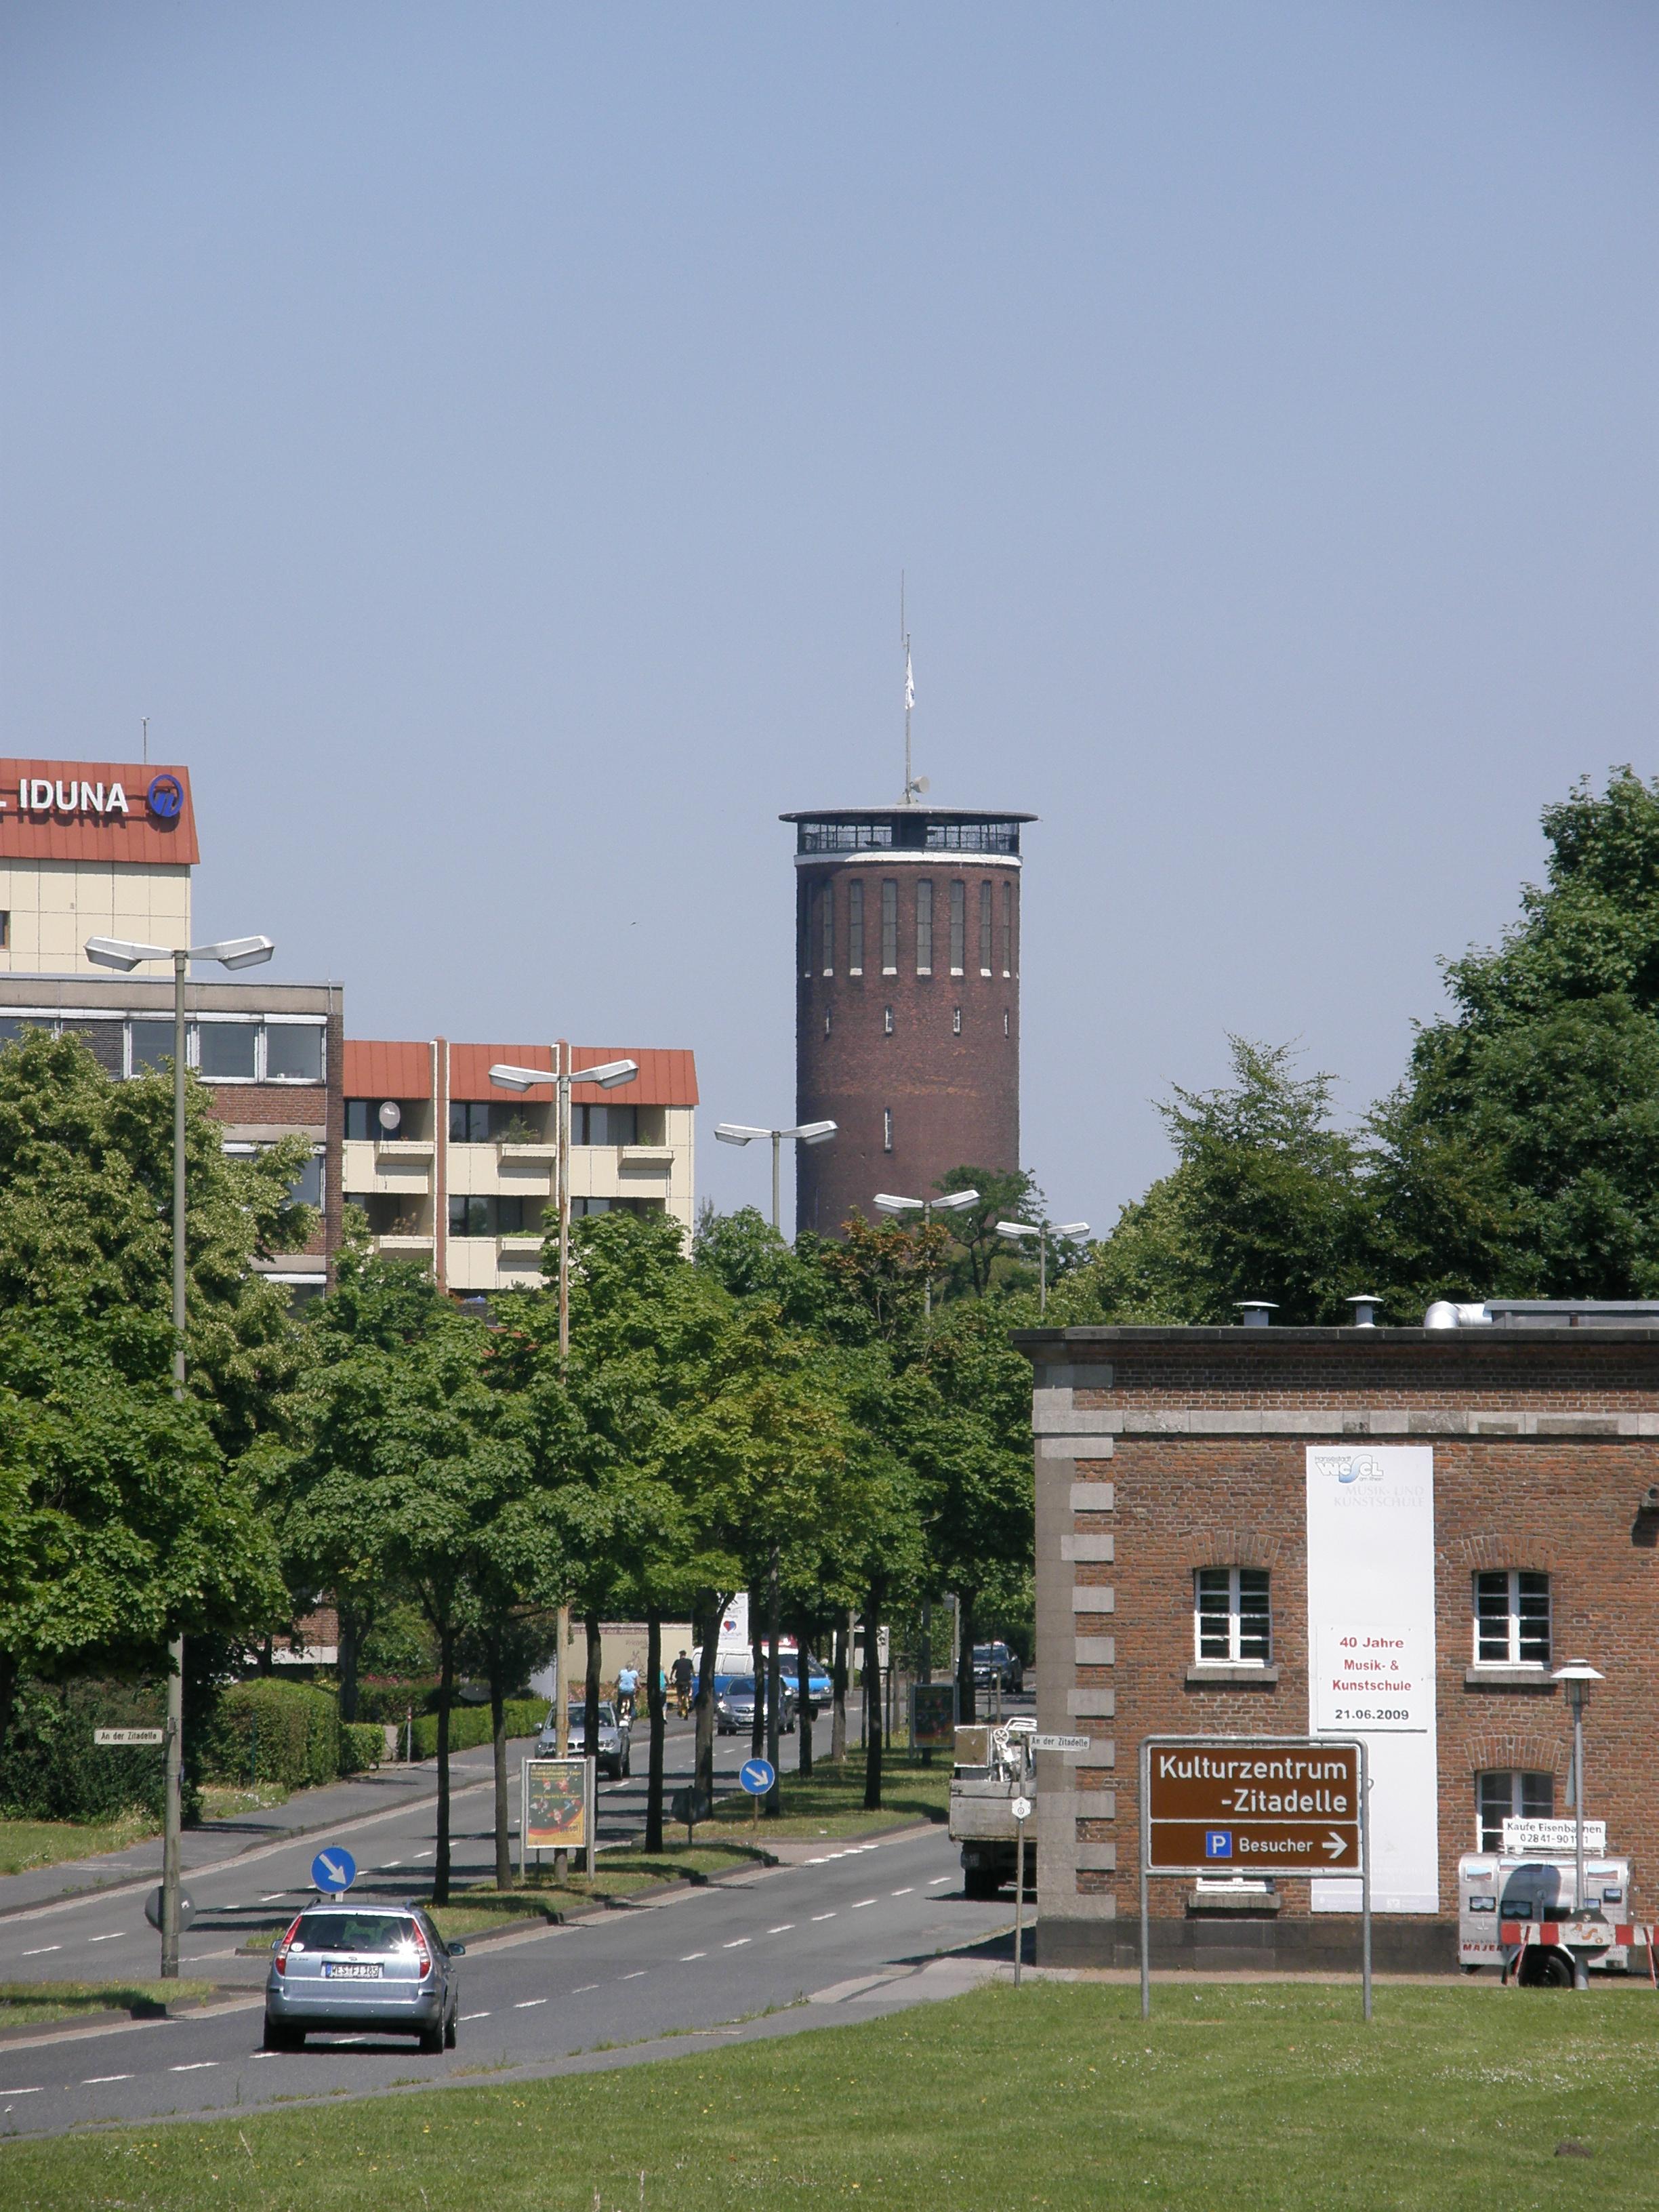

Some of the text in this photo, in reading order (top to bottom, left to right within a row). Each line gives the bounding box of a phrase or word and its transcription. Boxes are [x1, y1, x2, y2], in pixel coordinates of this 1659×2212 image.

[20, 779, 129, 813] IDUNA
[1395, 1485, 1425, 1496] UND
[1334, 1496, 1425, 1507] KUNSTSCHULE
[1339, 1637, 1404, 1648] 40 Jahre
[1344, 1660, 1399, 1671] Musik- &
[1332, 1679, 1412, 1691] Kunstschule
[1335, 1709, 1409, 1719] 21.06.2009
[101, 1732, 157, 1740] An der Zitadelle
[1031, 1737, 1088, 1747] An der Zitadelle
[1160, 1755, 1347, 1780] Kulturzentrum
[1222, 1789, 1347, 1812] -Zitadelle
[1507, 1822, 1602, 1833] Kaufe Eisenbanen
[1212, 1835, 1313, 1854] P Besucher
